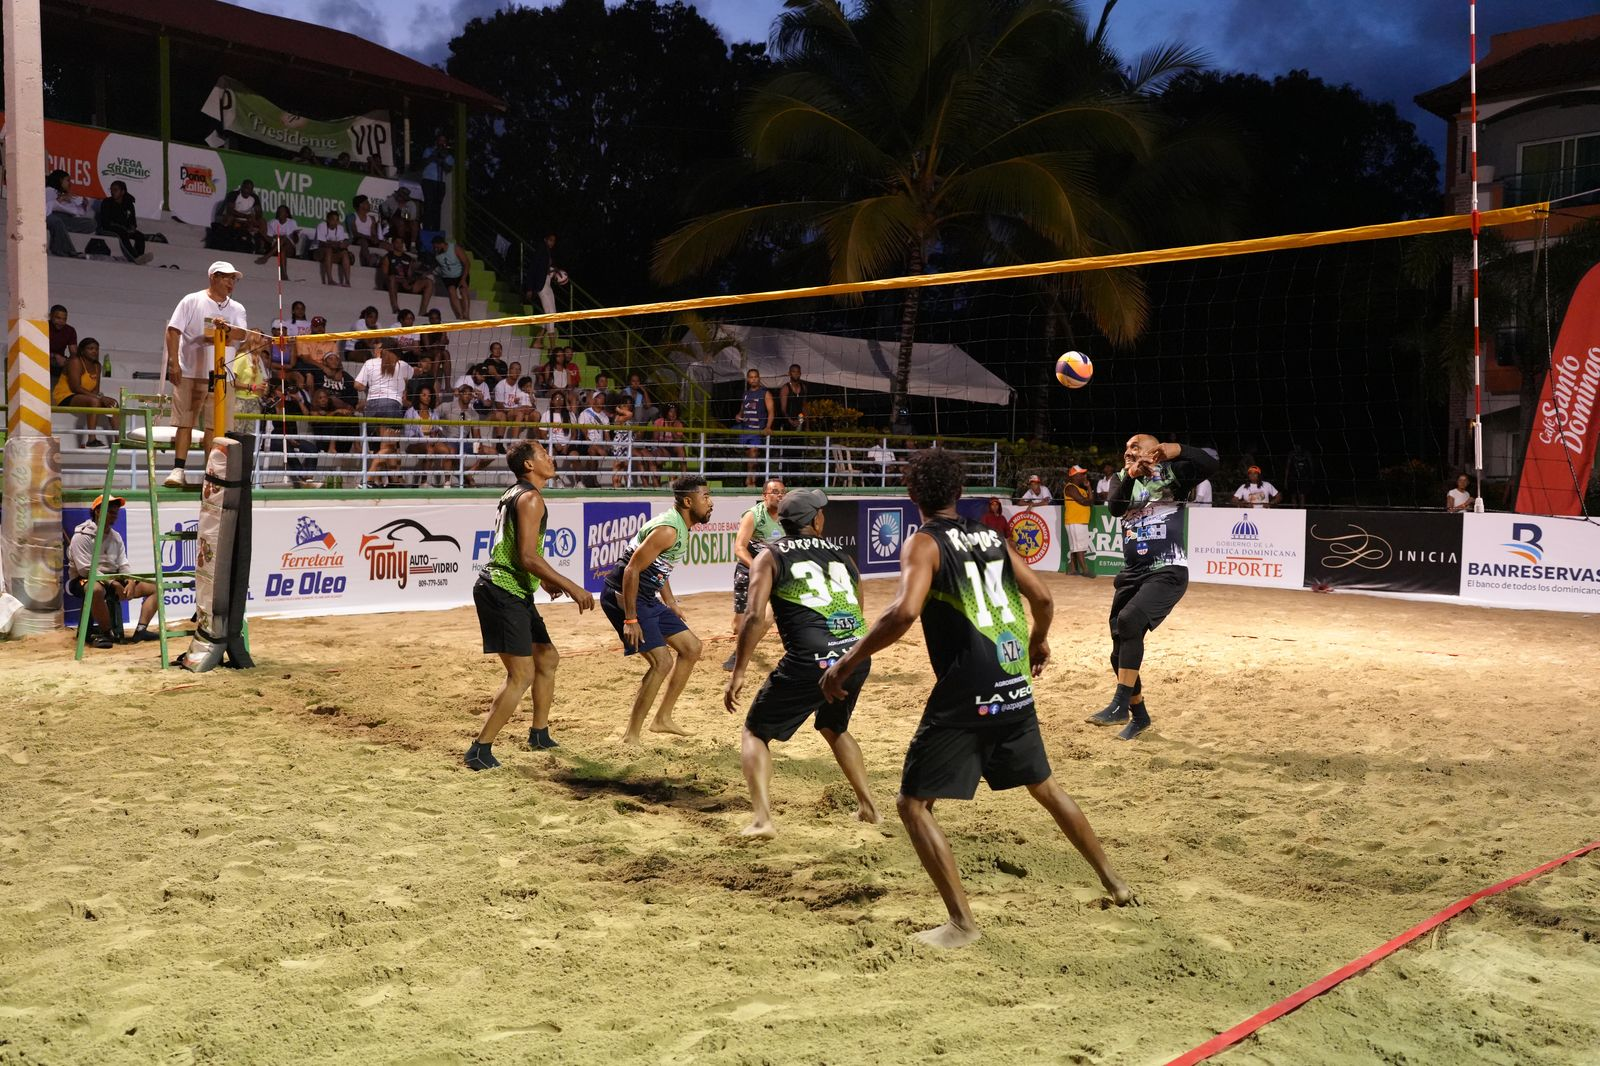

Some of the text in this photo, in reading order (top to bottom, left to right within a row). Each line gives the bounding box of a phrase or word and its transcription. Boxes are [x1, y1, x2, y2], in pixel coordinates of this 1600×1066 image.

[248, 112, 338, 149] Presidente
[350, 124, 386, 155] VIP
[117, 157, 143, 169] VEGA
[275, 168, 313, 193] VIP
[1542, 355, 1580, 427] Santo
[587, 512, 647, 547] RICARDO
[682, 532, 738, 566] JOSELIT
[825, 535, 856, 546] NICIA
[945, 528, 1002, 553] RAMOS
[281, 551, 344, 568] Ferretería
[409, 554, 429, 566] AUTO
[559, 559, 570, 567] ARS
[1242, 549, 1297, 557] DOMINICANA
[1399, 550, 1458, 564] INICIA
[364, 543, 408, 590] Tony
[432, 562, 459, 574] VIDRIO
[1206, 560, 1283, 578] DEPORTE
[265, 573, 294, 597] De
[298, 571, 347, 595] Oleo
[790, 559, 859, 608] 34
[964, 559, 1017, 628] 14
[1476, 580, 1500, 589] banco
[1502, 581, 1512, 590] de
[1513, 582, 1537, 591] todos
[1538, 583, 1550, 592] los
[975, 693, 1005, 705] LA
